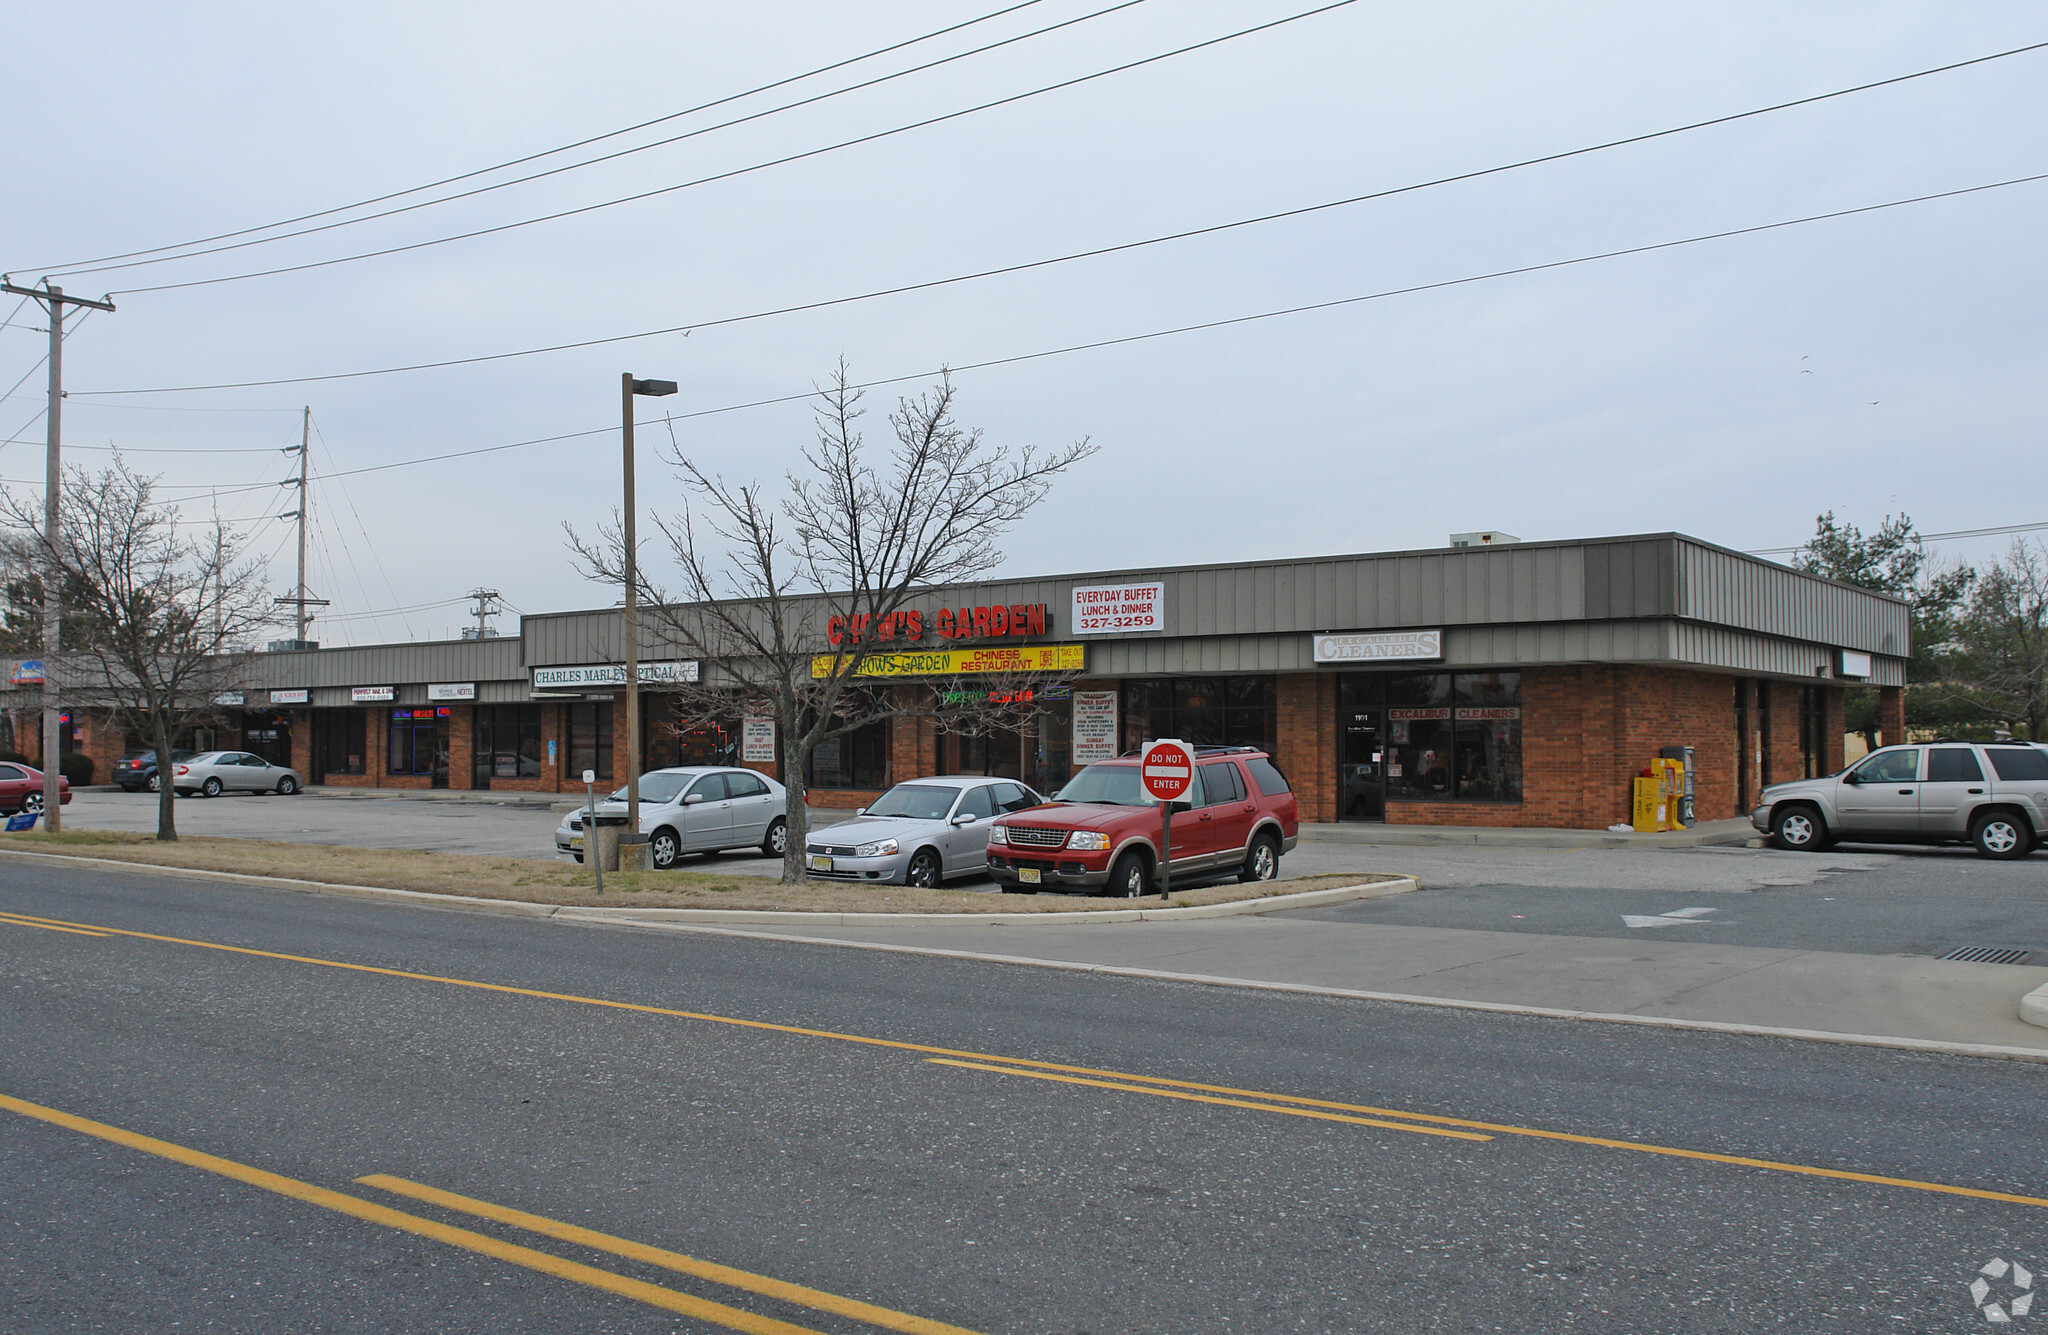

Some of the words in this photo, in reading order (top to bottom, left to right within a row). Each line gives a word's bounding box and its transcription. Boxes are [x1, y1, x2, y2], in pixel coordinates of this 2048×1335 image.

[1076, 590, 1122, 603] EVERYDAY
[1124, 588, 1158, 601] BUFFET
[1082, 605, 1110, 616] LUNCH
[1112, 604, 1119, 615] &
[1121, 603, 1153, 614] DINNER
[936, 603, 1046, 640] GARDEN
[1080, 615, 1154, 629] 327-3259
[1338, 634, 1417, 645] EXCALIBUR
[1317, 633, 1438, 659] CLEANERS
[973, 650, 1020, 661] CHINESE
[1061, 647, 1072, 657] TAKE
[1073, 647, 1083, 657] OUT
[856, 657, 895, 673] HOW'S
[902, 654, 950, 672] GARDEN
[961, 660, 1032, 672] RESTAURANT
[535, 670, 581, 684] CHARLES
[636, 666, 676, 680] PTICAL
[457, 688, 473, 696] NEXTEL
[1354, 714, 1368, 722] 1101
[1390, 709, 1449, 719] EXCALIBUR
[1458, 708, 1516, 719] CLEANERS
[1152, 754, 1162, 763] DO
[1166, 754, 1182, 763] NOT
[1153, 779, 1180, 789] ENTER
